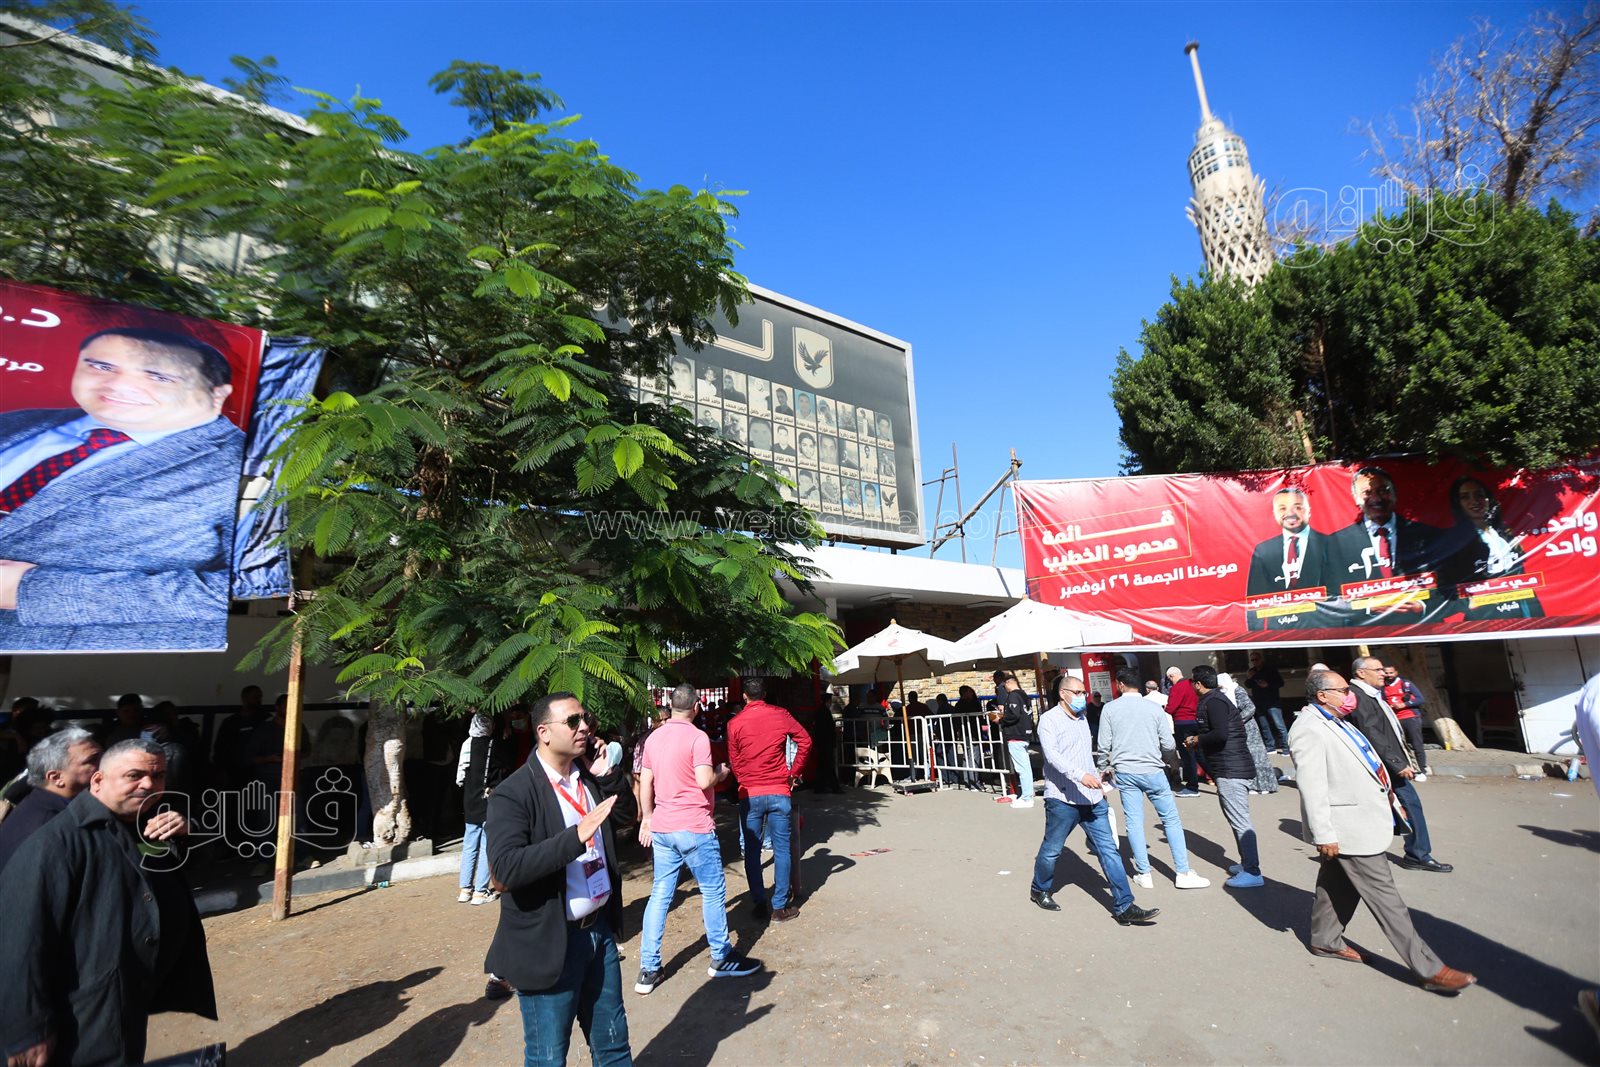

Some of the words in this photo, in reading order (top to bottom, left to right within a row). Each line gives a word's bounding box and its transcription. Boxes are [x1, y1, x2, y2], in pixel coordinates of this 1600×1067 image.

[1113, 537, 1178, 562] محمود
[1545, 533, 1598, 557] واحد
[1042, 544, 1109, 573] الخطيب
[1109, 573, 1129, 588] ٢٦
[1133, 567, 1184, 585] الجمعة
[1187, 563, 1238, 579] موعدنا
[1059, 579, 1106, 600] نوفمبر
[1294, 591, 1321, 602] محمد
